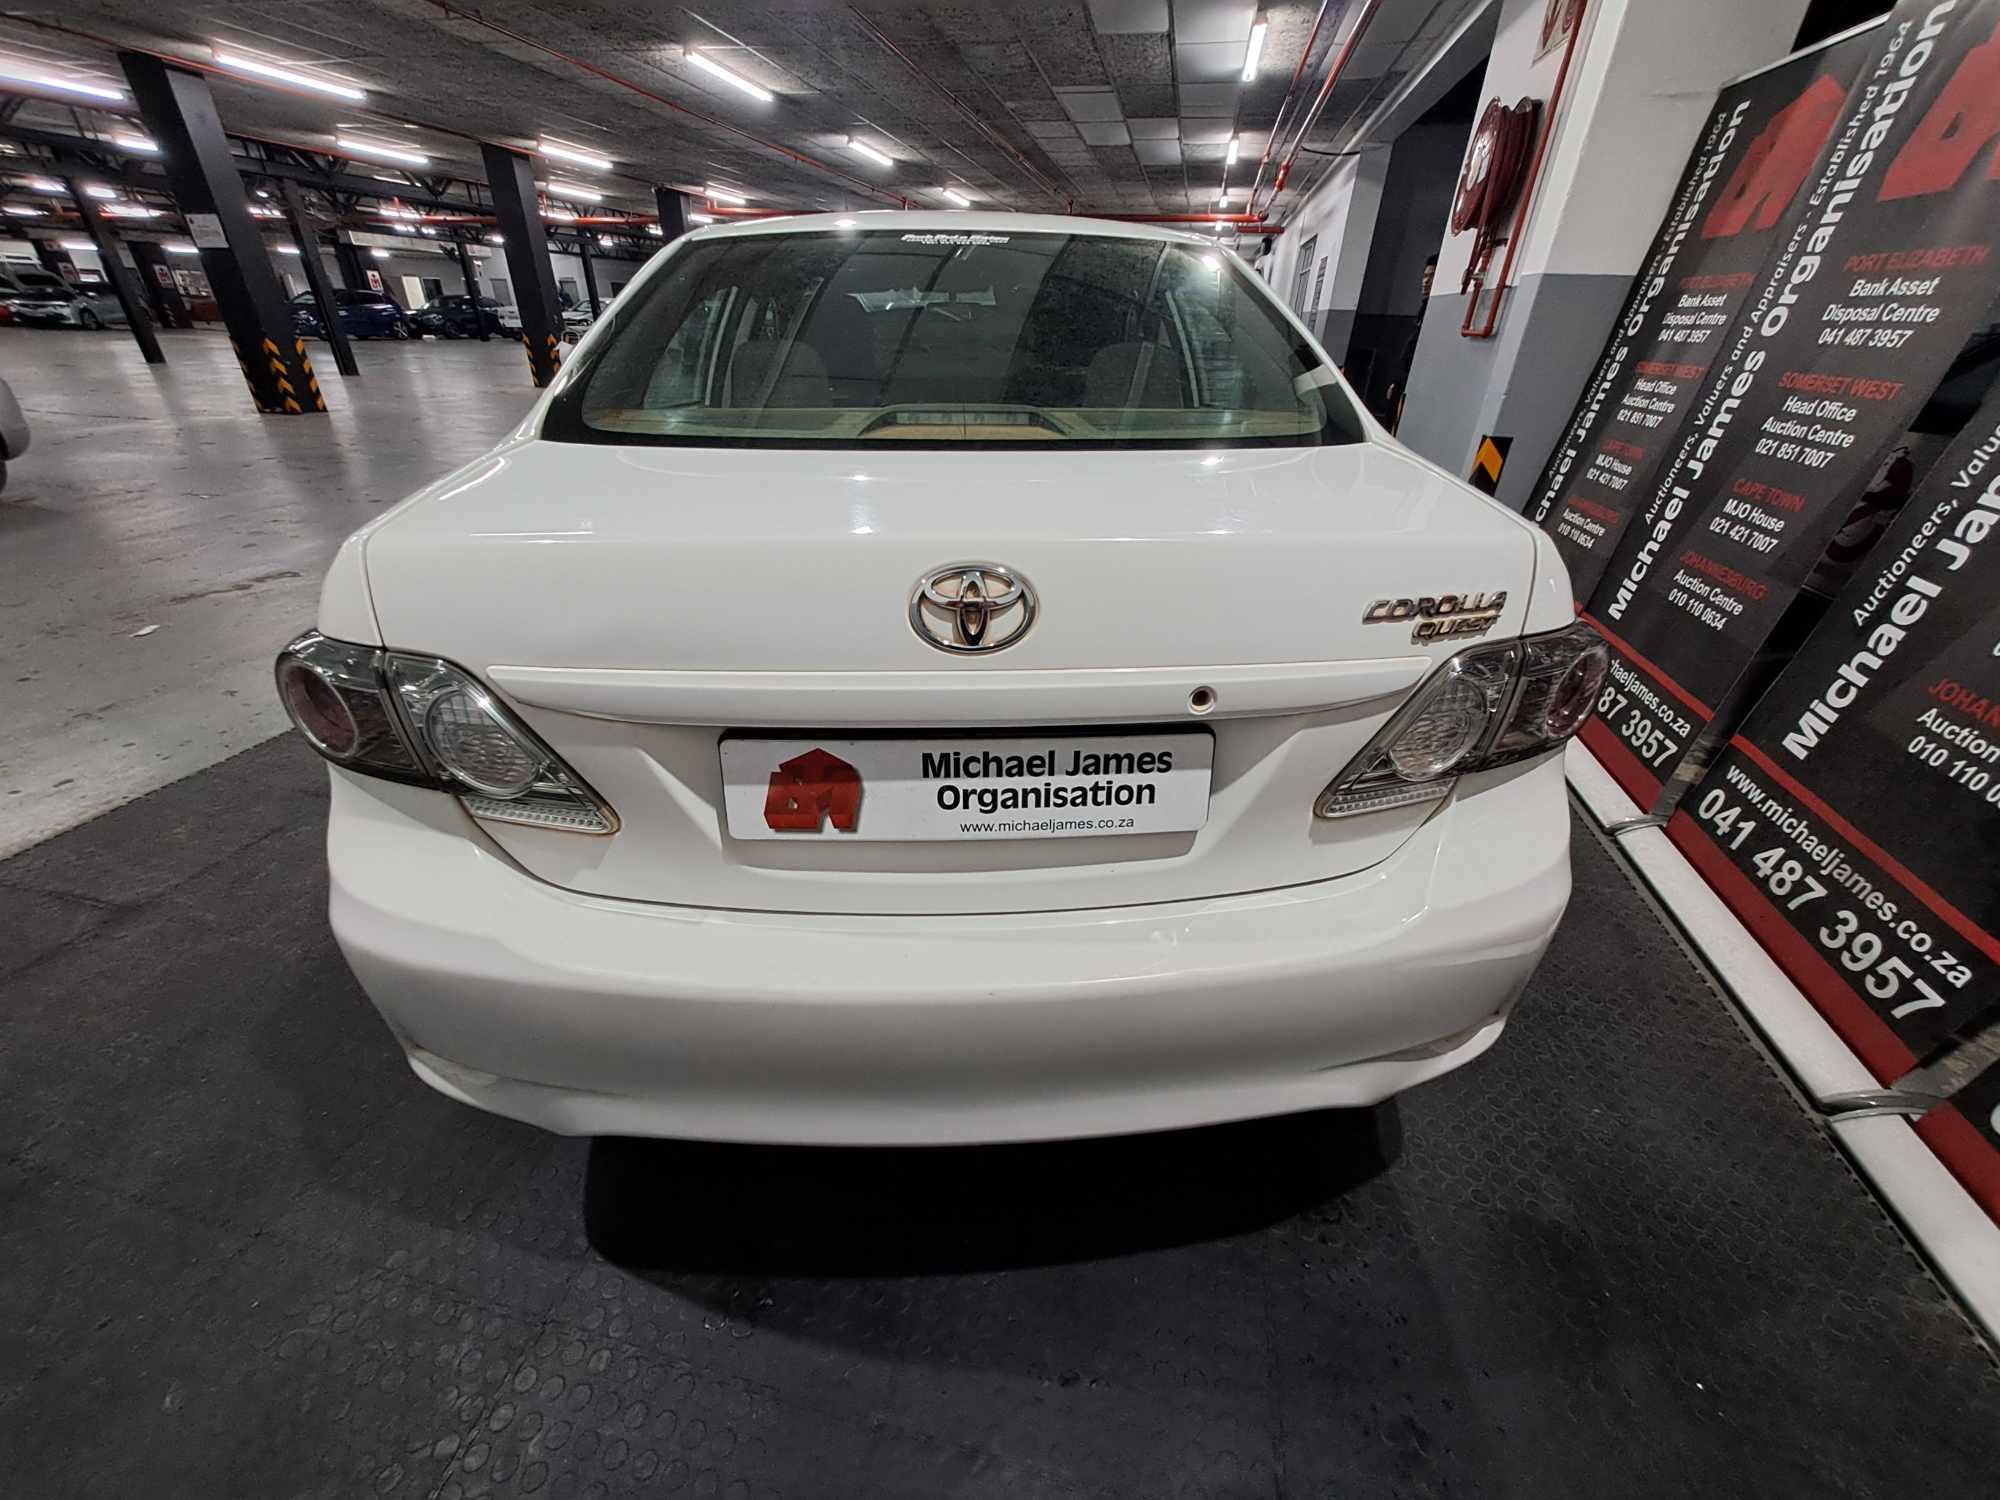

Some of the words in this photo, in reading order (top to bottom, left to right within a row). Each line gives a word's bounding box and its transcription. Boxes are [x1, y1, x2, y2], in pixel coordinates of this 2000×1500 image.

[1610, 328, 1626, 355] and
[1623, 254, 1662, 327] Appraisers
[1663, 156, 1708, 242] Established
[1703, 112, 1728, 152] 1964
[1577, 346, 1628, 443] James
[1627, 100, 1751, 337] Organisation
[1644, 432, 1700, 526] Auctioneers,
[1694, 364, 1733, 425] Valuers
[1731, 326, 1753, 361] and
[1750, 223, 1808, 324] Appraisers
[1809, 85, 1880, 206] Established
[1874, 20, 1913, 80] 1964
[1844, 253, 1888, 272] PORT
[1886, 245, 1992, 270] ELIZABETH
[1678, 294, 1702, 308] Bank
[1699, 293, 1728, 308] Asset
[1848, 277, 1889, 298] Bank
[1885, 275, 1943, 296] Asset
[1607, 485, 1691, 621] Michael
[1687, 350, 1767, 480] James
[1761, 1, 1955, 337] Organisation
[1661, 311, 1699, 328] Disposal
[1695, 311, 1727, 326] Centre
[1822, 303, 1886, 325] Disposal
[1881, 303, 1941, 324] Centre
[1818, 327, 1843, 345] 041
[1843, 328, 1873, 347] 487
[1868, 329, 1915, 348] 3957
[1621, 393, 1651, 409] Auction
[1648, 397, 1676, 413] Centre
[1634, 378, 1657, 393] Head
[1654, 380, 1678, 396] Office
[1777, 372, 1851, 396] SOMERSET
[1850, 378, 1905, 401] WEST
[1782, 395, 1817, 417] Head
[1816, 400, 1858, 423] Office
[1761, 416, 1808, 440] Auction
[1807, 423, 1855, 448] Centre
[1610, 458, 1633, 476] House
[1755, 437, 1778, 456] 021
[1776, 442, 1802, 462] 851
[1797, 447, 1836, 469] 7007
[1732, 479, 1765, 502] CAPE
[1762, 485, 1807, 513] TOWN
[1582, 518, 1607, 537] Centre
[1723, 498, 1752, 520] MJO
[1747, 508, 1786, 532] House
[1709, 516, 1732, 536] 021
[1728, 524, 1751, 545] 421
[1746, 531, 1779, 554] 7007
[1853, 499, 1958, 627] Auctioneers,
[1362, 591, 1507, 625] COROLLA
[1673, 568, 1711, 597] Auction
[1708, 587, 1745, 616] Centre
[1668, 588, 1688, 608] 010
[1686, 597, 1706, 617] 110
[1700, 606, 1729, 631] 0634
[1411, 614, 1501, 646] QUEST
[1781, 575, 1943, 761] Michael
[1610, 659, 1691, 738] haeljames.co.za
[1598, 683, 1629, 720] 87
[1621, 709, 1679, 768] 3957
[1916, 708, 2000, 764] Auction
[921, 750, 1056, 779] Michael
[1065, 750, 1173, 777] James
[1907, 735, 1949, 767] 010
[1948, 760, 1990, 792] 110
[936, 780, 1157, 815] Organisation
[959, 816, 1136, 834] www.michaeljames.co.za
[1725, 764, 1973, 990] www.michaeljames.co.za
[1699, 788, 1757, 851] 041
[1752, 847, 1829, 911] 487
[1818, 909, 1947, 1020] 3957
